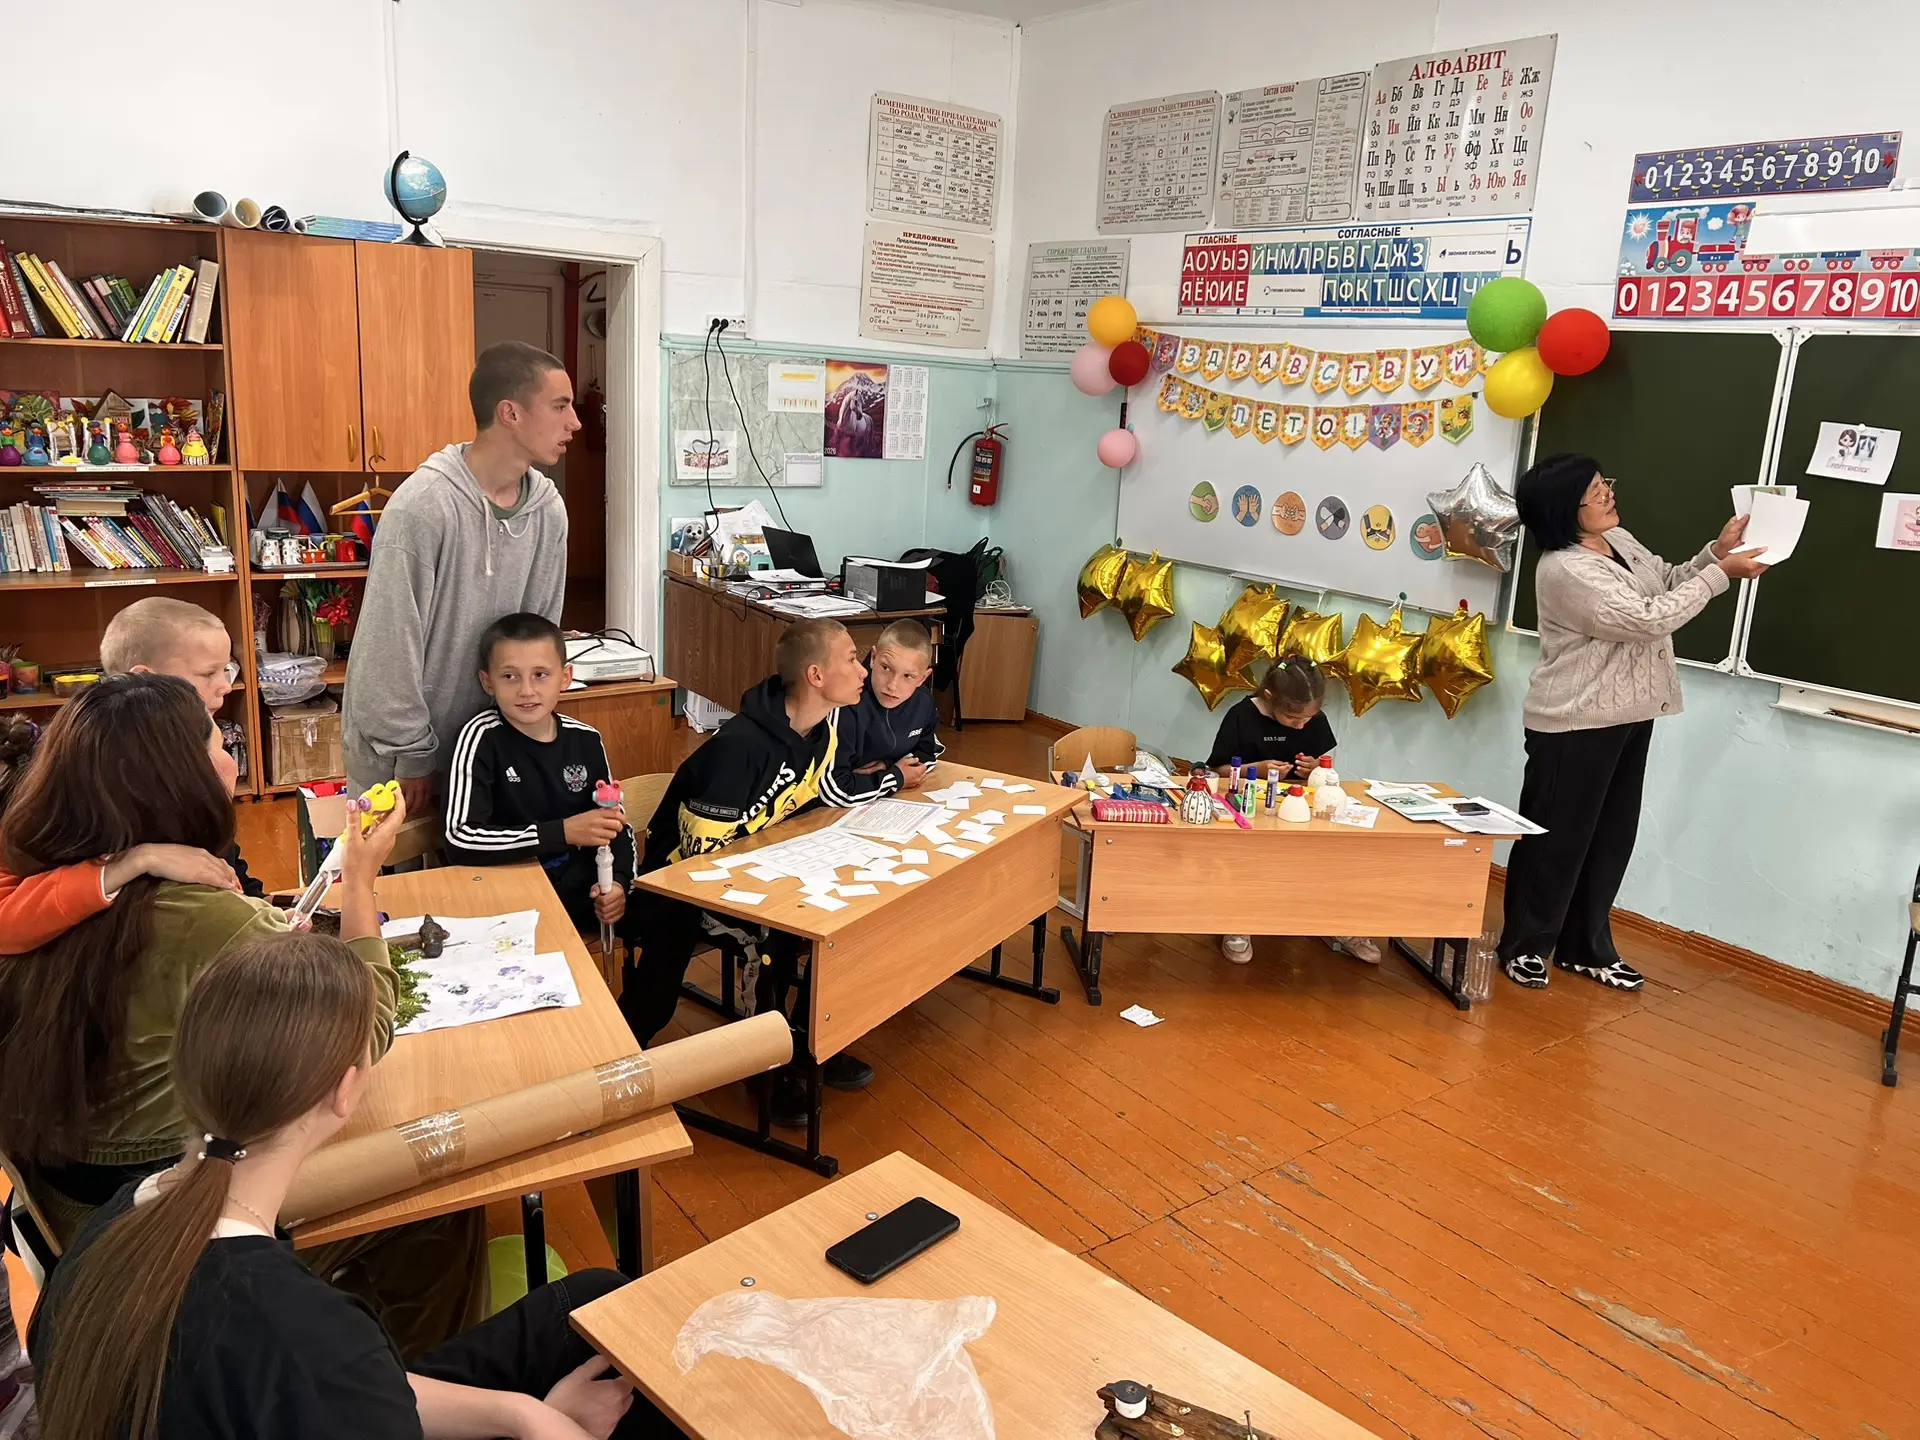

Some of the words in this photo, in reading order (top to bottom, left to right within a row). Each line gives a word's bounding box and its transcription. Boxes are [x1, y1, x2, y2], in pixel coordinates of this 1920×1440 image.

[1409, 50, 1506, 81] АЛФАВИТ
[1264, 87, 1279, 95] Состав
[1375, 90, 1386, 105] Аа
[1391, 86, 1403, 101] Бб
[1413, 84, 1424, 99] Вв
[1434, 80, 1444, 96] Гг
[1450, 78, 1464, 96] Дд
[1476, 74, 1488, 90] Ее
[1501, 69, 1513, 87] Ёё
[1520, 67, 1540, 85] Жж
[877, 98, 919, 113] ИЗМЕНЕНИЕ
[920, 107, 940, 116] ИМЕН
[941, 111, 997, 128] ПРИЛАГАТЕЛЬНЫХ
[1371, 121, 1380, 136] Зз
[1387, 119, 1400, 134] Ии
[1407, 115, 1421, 131] Йй
[1427, 114, 1440, 130] Кк
[1446, 112, 1459, 127] Лл
[1469, 109, 1484, 125] Мм
[1494, 106, 1508, 122] Нн
[1521, 102, 1533, 118] Оо
[1367, 151, 1379, 166] Пп
[1385, 149, 1395, 167] Рр
[1406, 147, 1415, 162] Сс
[1425, 145, 1435, 160] Тт
[1444, 143, 1456, 161] Уу
[1465, 141, 1481, 159] Фф
[1490, 139, 1503, 154] Хх
[1513, 136, 1527, 153] Цц
[1365, 183, 1375, 197] Чч
[1379, 182, 1394, 196] Шш
[1398, 180, 1414, 196] Щщ
[1469, 174, 1481, 190] Ээ
[1487, 173, 1506, 188] Юю
[1513, 170, 1526, 186] Яя
[1645, 166, 1657, 189] 0
[1664, 165, 1673, 187] 1
[1679, 163, 1693, 186] 2
[1700, 162, 1712, 184] 3
[1720, 159, 1733, 182] 4
[1741, 158, 1754, 181] 5
[1762, 156, 1775, 180] 6
[1784, 155, 1798, 178] 7
[1805, 153, 1819, 177] 8
[1828, 151, 1843, 176] 9
[1851, 149, 1880, 173] 10
[903, 232, 955, 244] ПРЕДЛОЖЕНИЕ
[1198, 235, 1237, 244] ГЛАСНЫЕ
[1338, 227, 1401, 238] СОГЛАСНЫЕ
[1620, 283, 1638, 312] 0
[1648, 282, 1658, 311] 1
[1666, 282, 1686, 312] 2
[1691, 281, 1712, 310] 3
[1718, 281, 1739, 311] 4
[1744, 280, 1767, 311] 5
[1772, 280, 1795, 310] 6
[1802, 280, 1825, 311] 7
[1829, 279, 1852, 311] 8
[1860, 279, 1884, 312] 9
[1890, 278, 1918, 311] 10
[1233, 406, 1357, 435] ЛЕТО!
